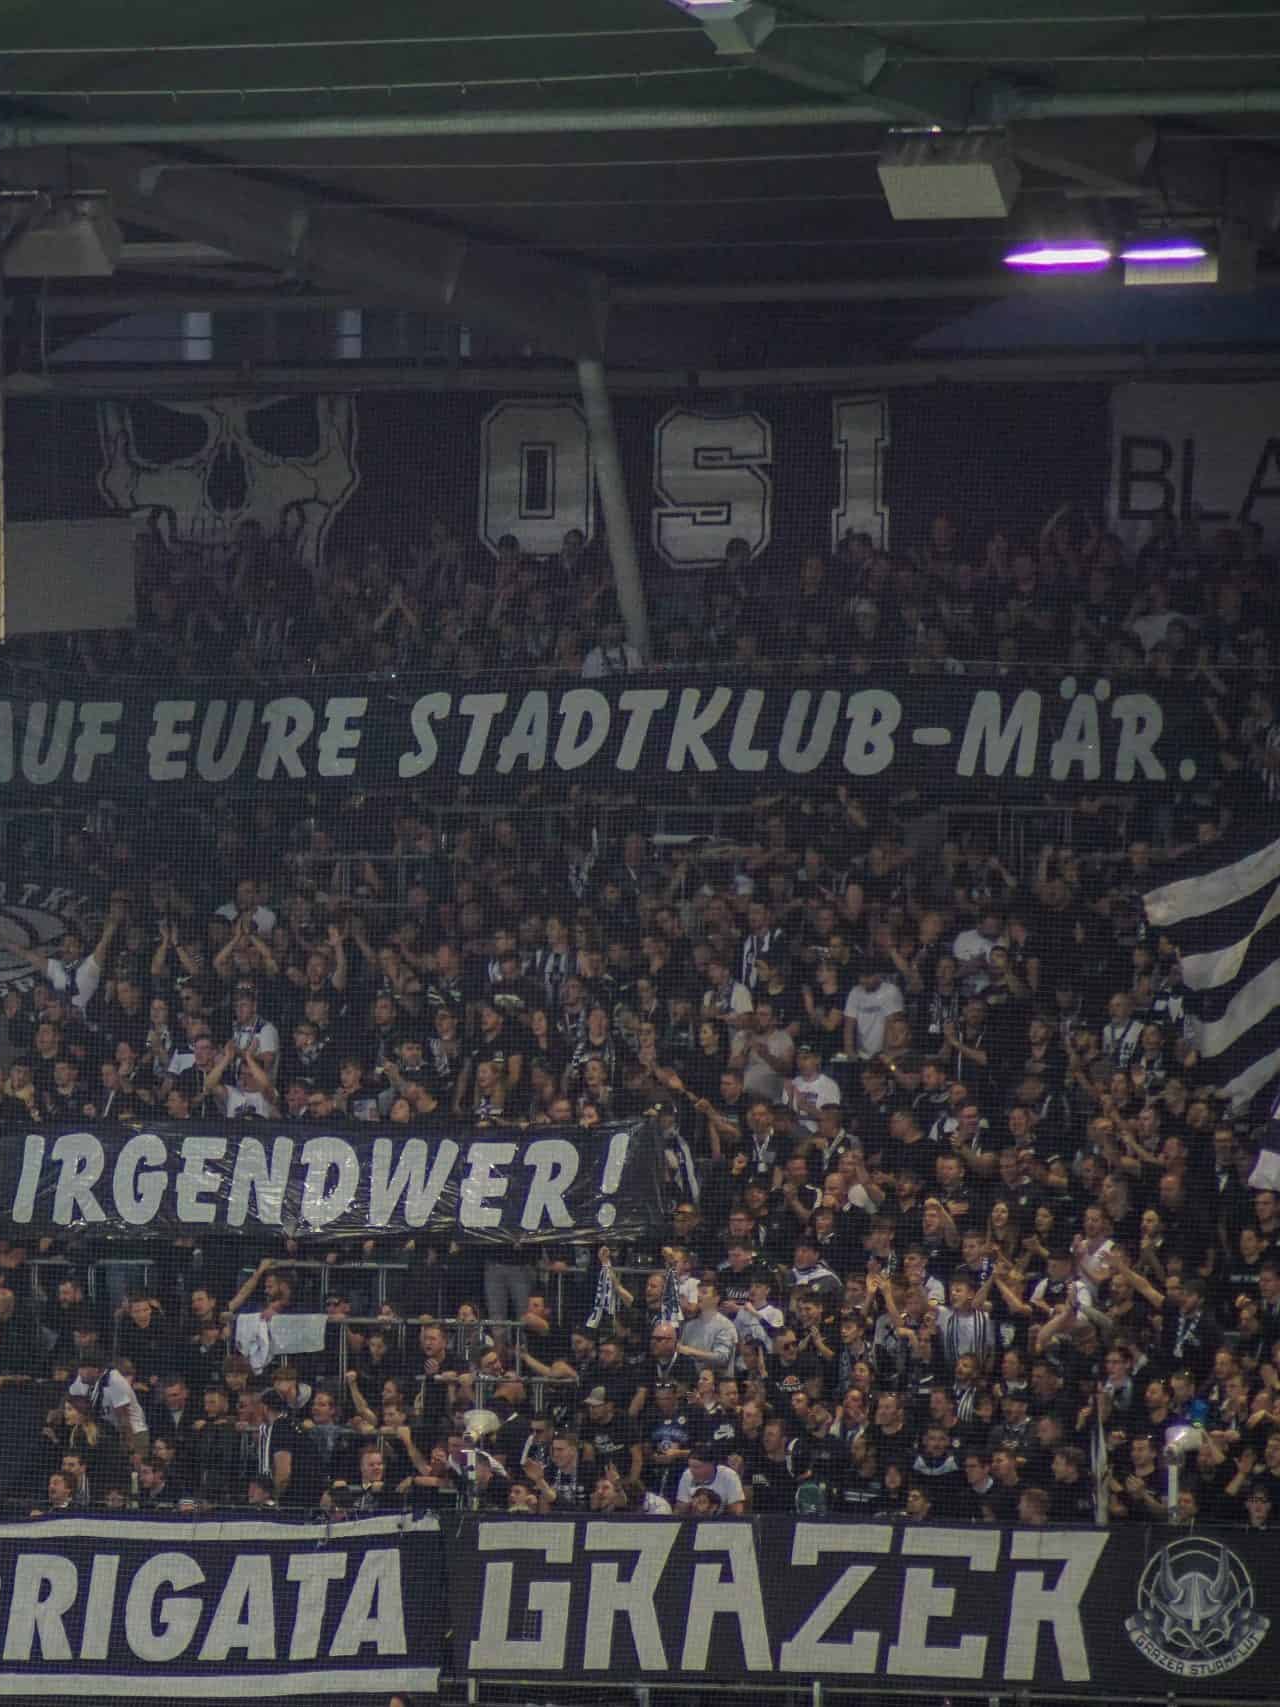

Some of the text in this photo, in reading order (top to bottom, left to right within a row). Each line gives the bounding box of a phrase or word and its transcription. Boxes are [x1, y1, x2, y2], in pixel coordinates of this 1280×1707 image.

[147, 696, 368, 782] EURE
[12, 1132, 630, 1230] IRGENDWER!
[467, 1521, 1110, 1681] GRAZER
[1135, 1632, 1185, 1674] GRAZER
